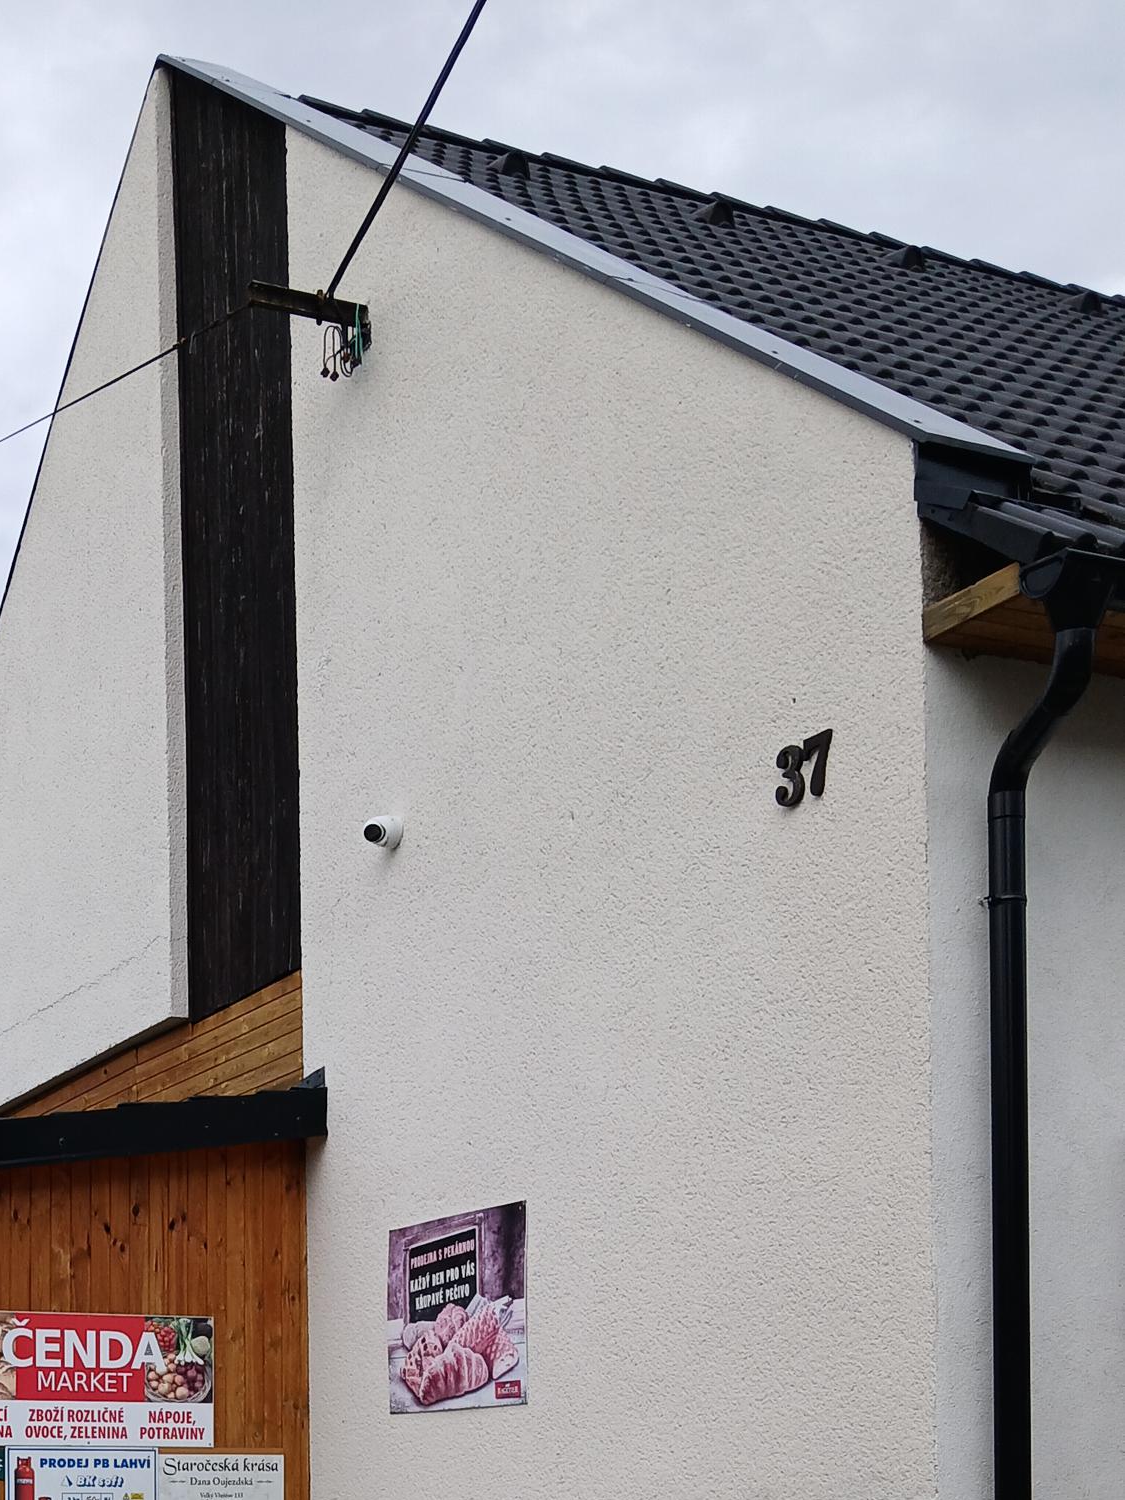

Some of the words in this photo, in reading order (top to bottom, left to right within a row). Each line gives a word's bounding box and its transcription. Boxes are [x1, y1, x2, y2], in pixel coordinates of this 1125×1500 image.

[775, 728, 833, 807] 37
[438, 1248, 442, 1261] S
[443, 1239, 475, 1259] PEKÁRNOU
[409, 1272, 430, 1293] KAŽDÝ
[431, 1271, 445, 1287] DEN
[445, 1266, 460, 1283] PRO
[460, 1260, 475, 1279] VÁS
[415, 1287, 444, 1310] KŘUPAVÉ
[445, 1283, 470, 1302] PEČIVO
[2, 1318, 168, 1371] ČENDA
[37, 1371, 132, 1393] MARKET
[28, 1406, 65, 1423] ZBOŽÍ
[67, 1407, 124, 1423] ROZLIČNÉ
[148, 1407, 197, 1426] NÁPOJE,
[25, 1425, 68, 1441] OVOCE,
[70, 1426, 128, 1440] ZELENINA
[139, 1426, 205, 1441] POTRAVINY
[39, 1457, 89, 1468] PRODEJ
[93, 1458, 110, 1468] PB
[113, 1455, 151, 1469] LAHVÍ
[162, 1457, 239, 1475] Staročeská
[243, 1457, 279, 1472] krása
[76, 1475, 97, 1487] BK
[190, 1477, 211, 1486] Dana
[212, 1476, 253, 1488] Oujezdská
